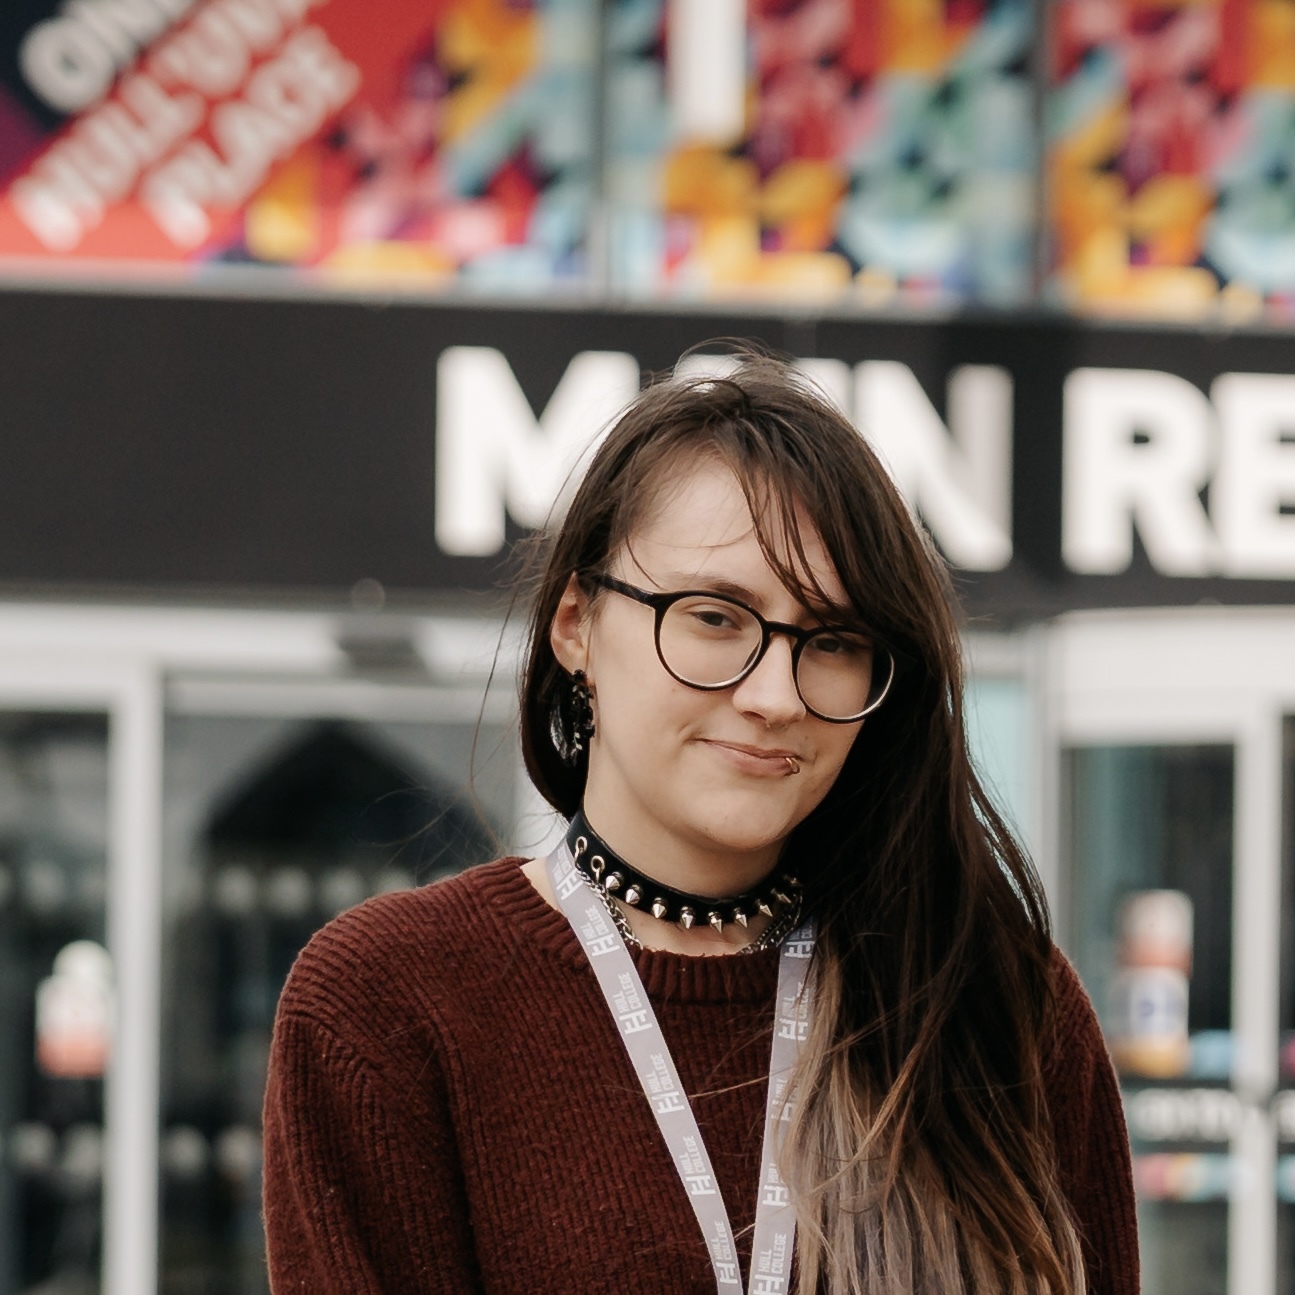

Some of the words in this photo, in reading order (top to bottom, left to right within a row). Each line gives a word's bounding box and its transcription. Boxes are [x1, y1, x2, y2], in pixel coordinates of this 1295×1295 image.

[434, 345, 1014, 572] MN
[612, 990, 631, 1014] HULL
[617, 971, 643, 1011] COLLEGE
[645, 1072, 663, 1095] HULL
[651, 1052, 676, 1091] COLLEGE
[678, 1153, 695, 1176] HULL
[682, 1134, 707, 1174] COLLEGE
[710, 1237, 725, 1261] HULL
[714, 1219, 733, 1261] COLLEGE
[770, 1232, 788, 1275] COLLEGE
[758, 1248, 773, 1273] HULL
